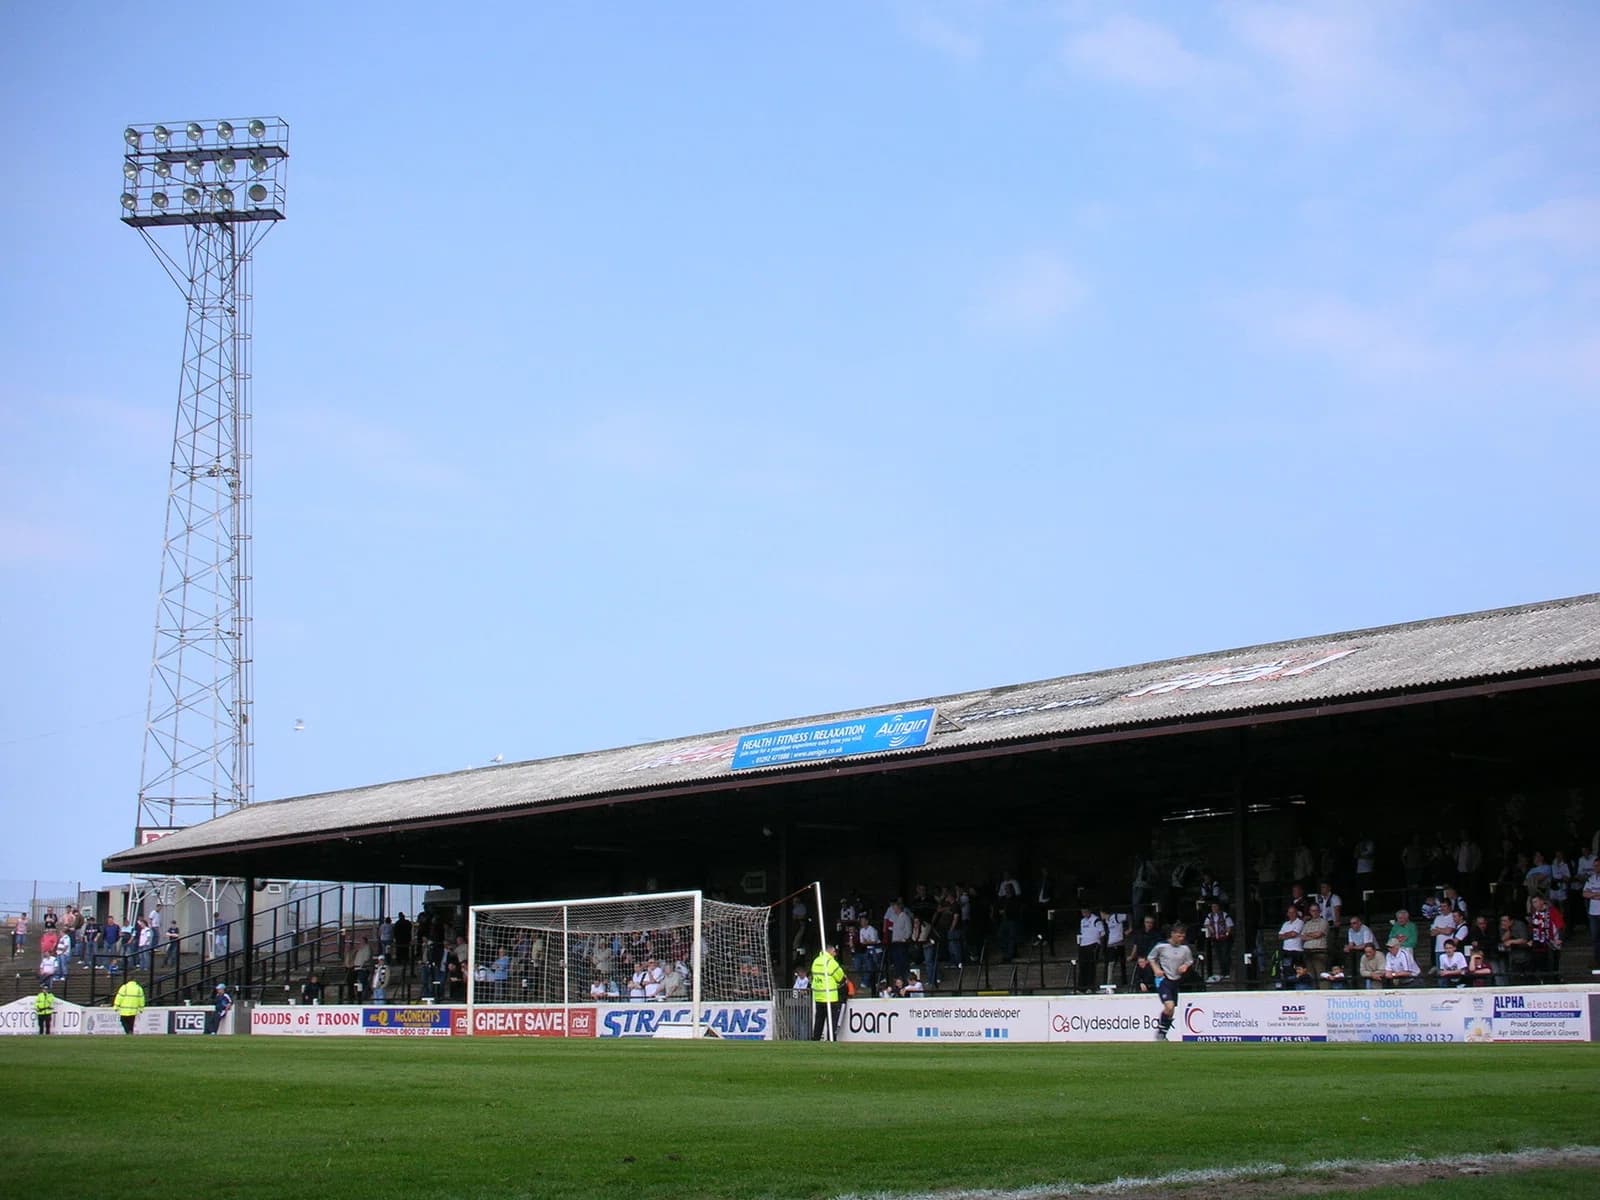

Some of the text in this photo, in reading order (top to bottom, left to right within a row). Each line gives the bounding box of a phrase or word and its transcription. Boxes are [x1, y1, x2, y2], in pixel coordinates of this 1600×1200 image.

[876, 718, 927, 736] Aurigin
[742, 725, 866, 750] HEALTH FITNESS RELAXATION
[1327, 998, 1403, 1010] Thinking about
[1494, 996, 1525, 1009] ALPHA
[1527, 1000, 1580, 1009] electrical
[63, 1011, 80, 1028] LTD
[253, 1013, 360, 1025] DODDS of TROON
[909, 1008, 1021, 1020] the premier stadia developer
[1212, 1010, 1241, 1020] Imperial
[1327, 1010, 1417, 1021] stopping smoking
[177, 1014, 204, 1029] TFG
[475, 1012, 524, 1031] GREAT
[849, 1008, 899, 1034] barr
[1071, 1015, 1140, 1032] Clydesdale
[1211, 1018, 1259, 1028] Commercials
[1529, 1020, 1556, 1028] Sponsors
[1558, 1020, 1566, 1028] of
[1372, 1033, 1400, 1042] 0800
[1403, 1033, 1422, 1042] 783
[1426, 1033, 1454, 1042] 9132
